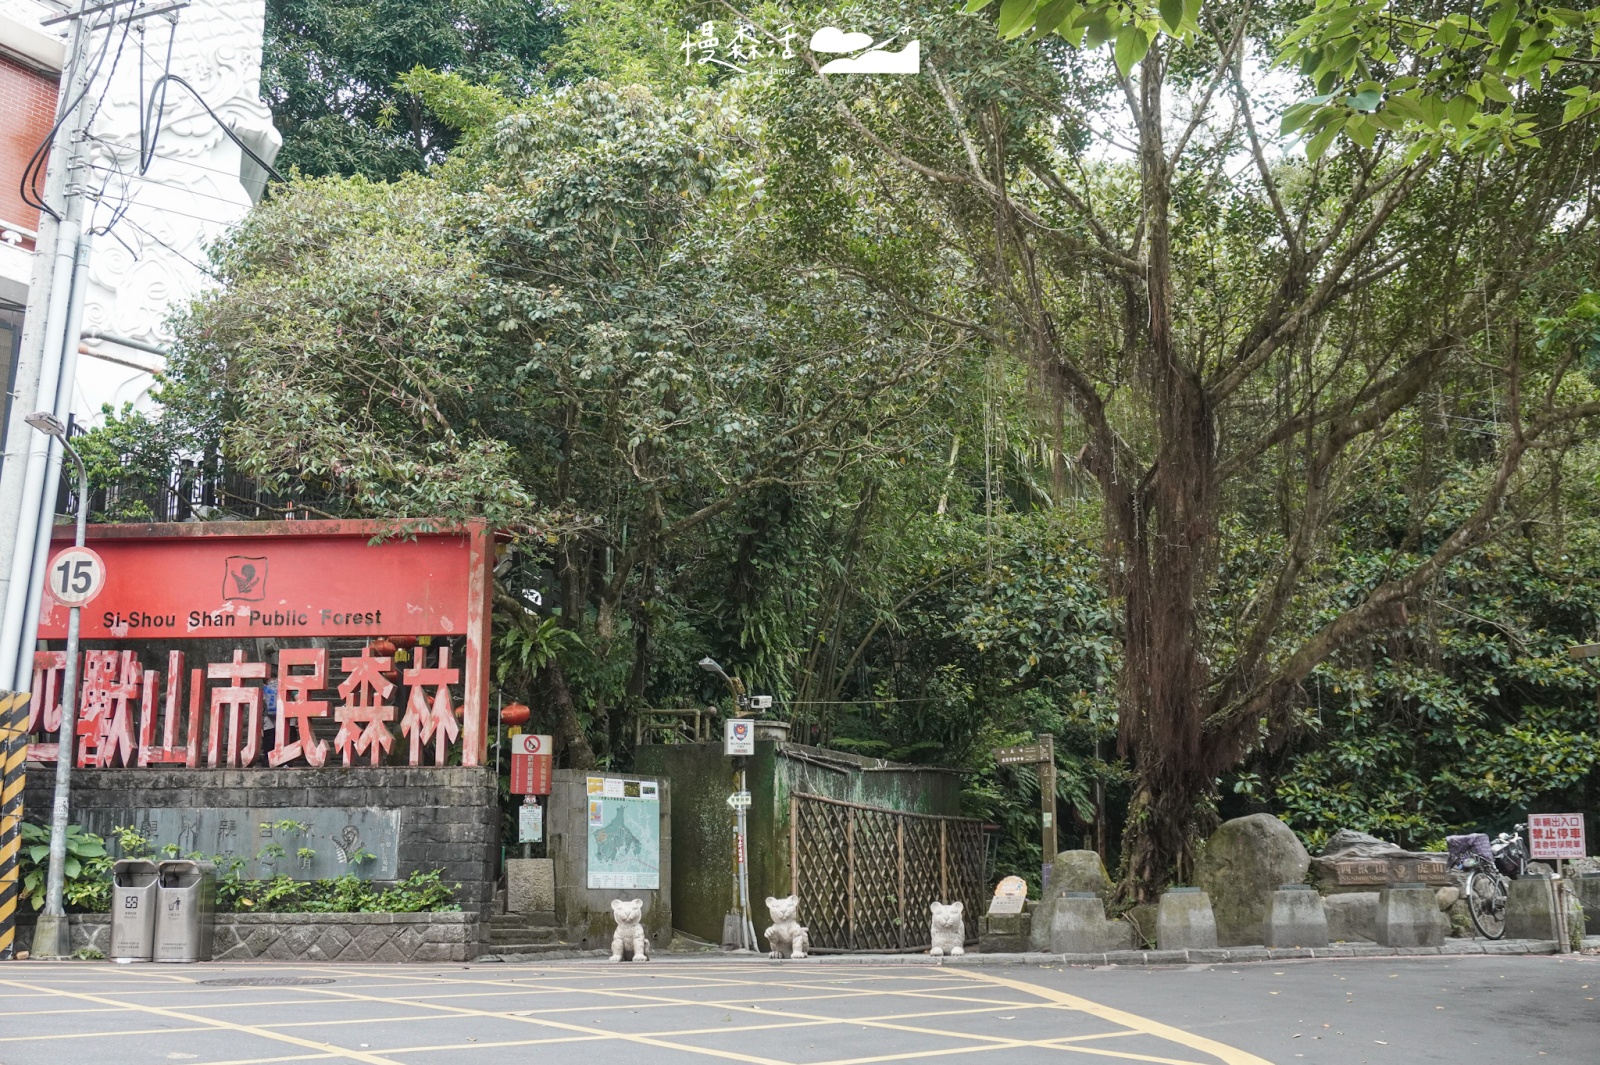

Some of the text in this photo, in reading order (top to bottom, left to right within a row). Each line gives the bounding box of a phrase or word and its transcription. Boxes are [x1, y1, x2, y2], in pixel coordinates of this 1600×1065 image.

[57, 560, 92, 594] 15
[103, 608, 382, 628] Si-Shou Shan Public Forest
[1534, 817, 1579, 827] 車輛出入口
[1533, 828, 1581, 839] 禁止停車
[1417, 863, 1444, 874] 虎山
